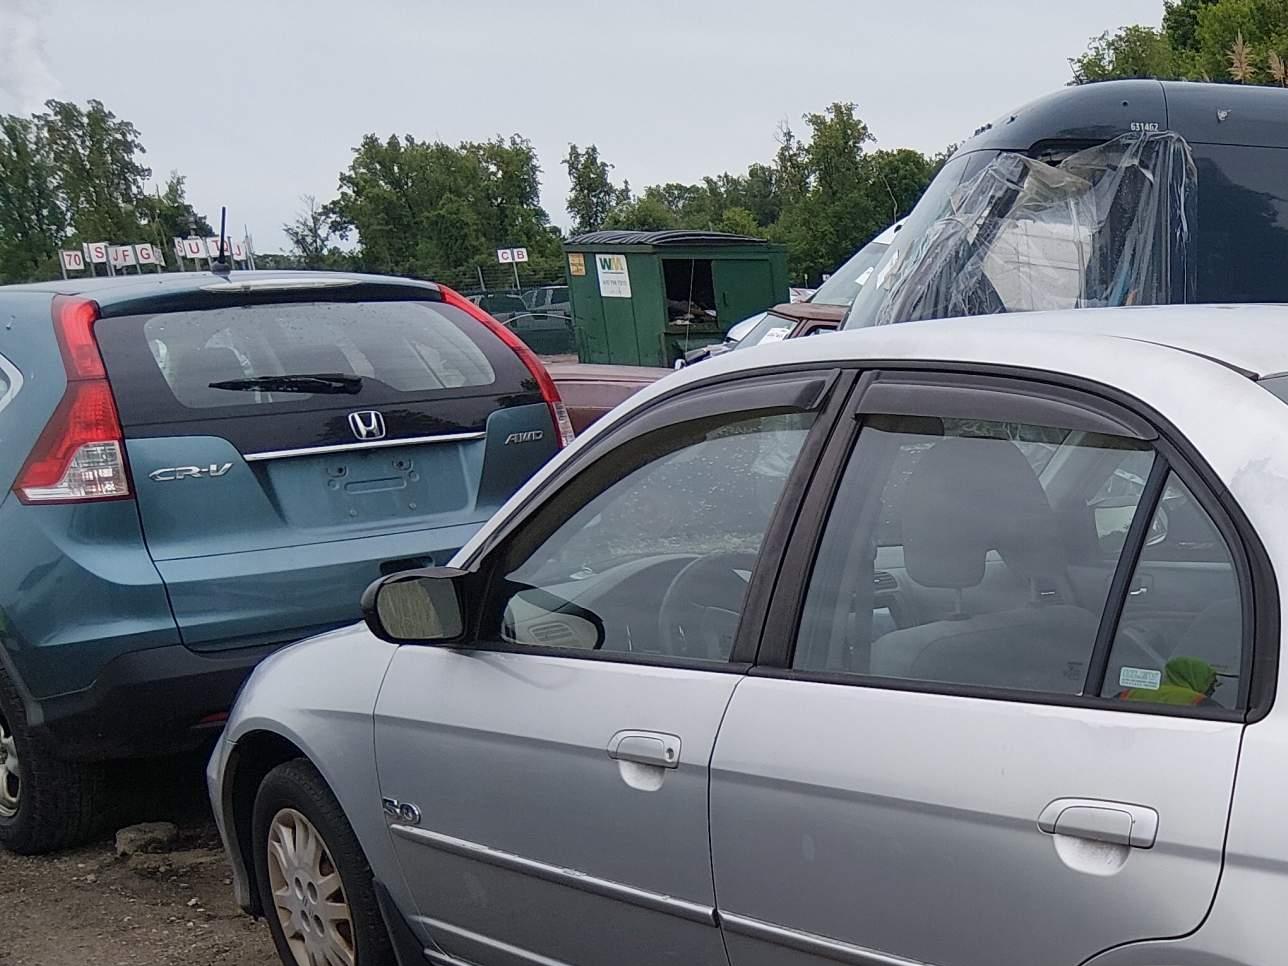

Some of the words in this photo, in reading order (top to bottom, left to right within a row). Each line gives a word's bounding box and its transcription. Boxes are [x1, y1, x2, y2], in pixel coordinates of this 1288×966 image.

[94, 246, 105, 259] S
[140, 247, 151, 260] G
[188, 242, 200, 254] U
[65, 253, 81, 266] 70
[504, 430, 544, 445] AWD
[148, 462, 233, 481] CR-V
